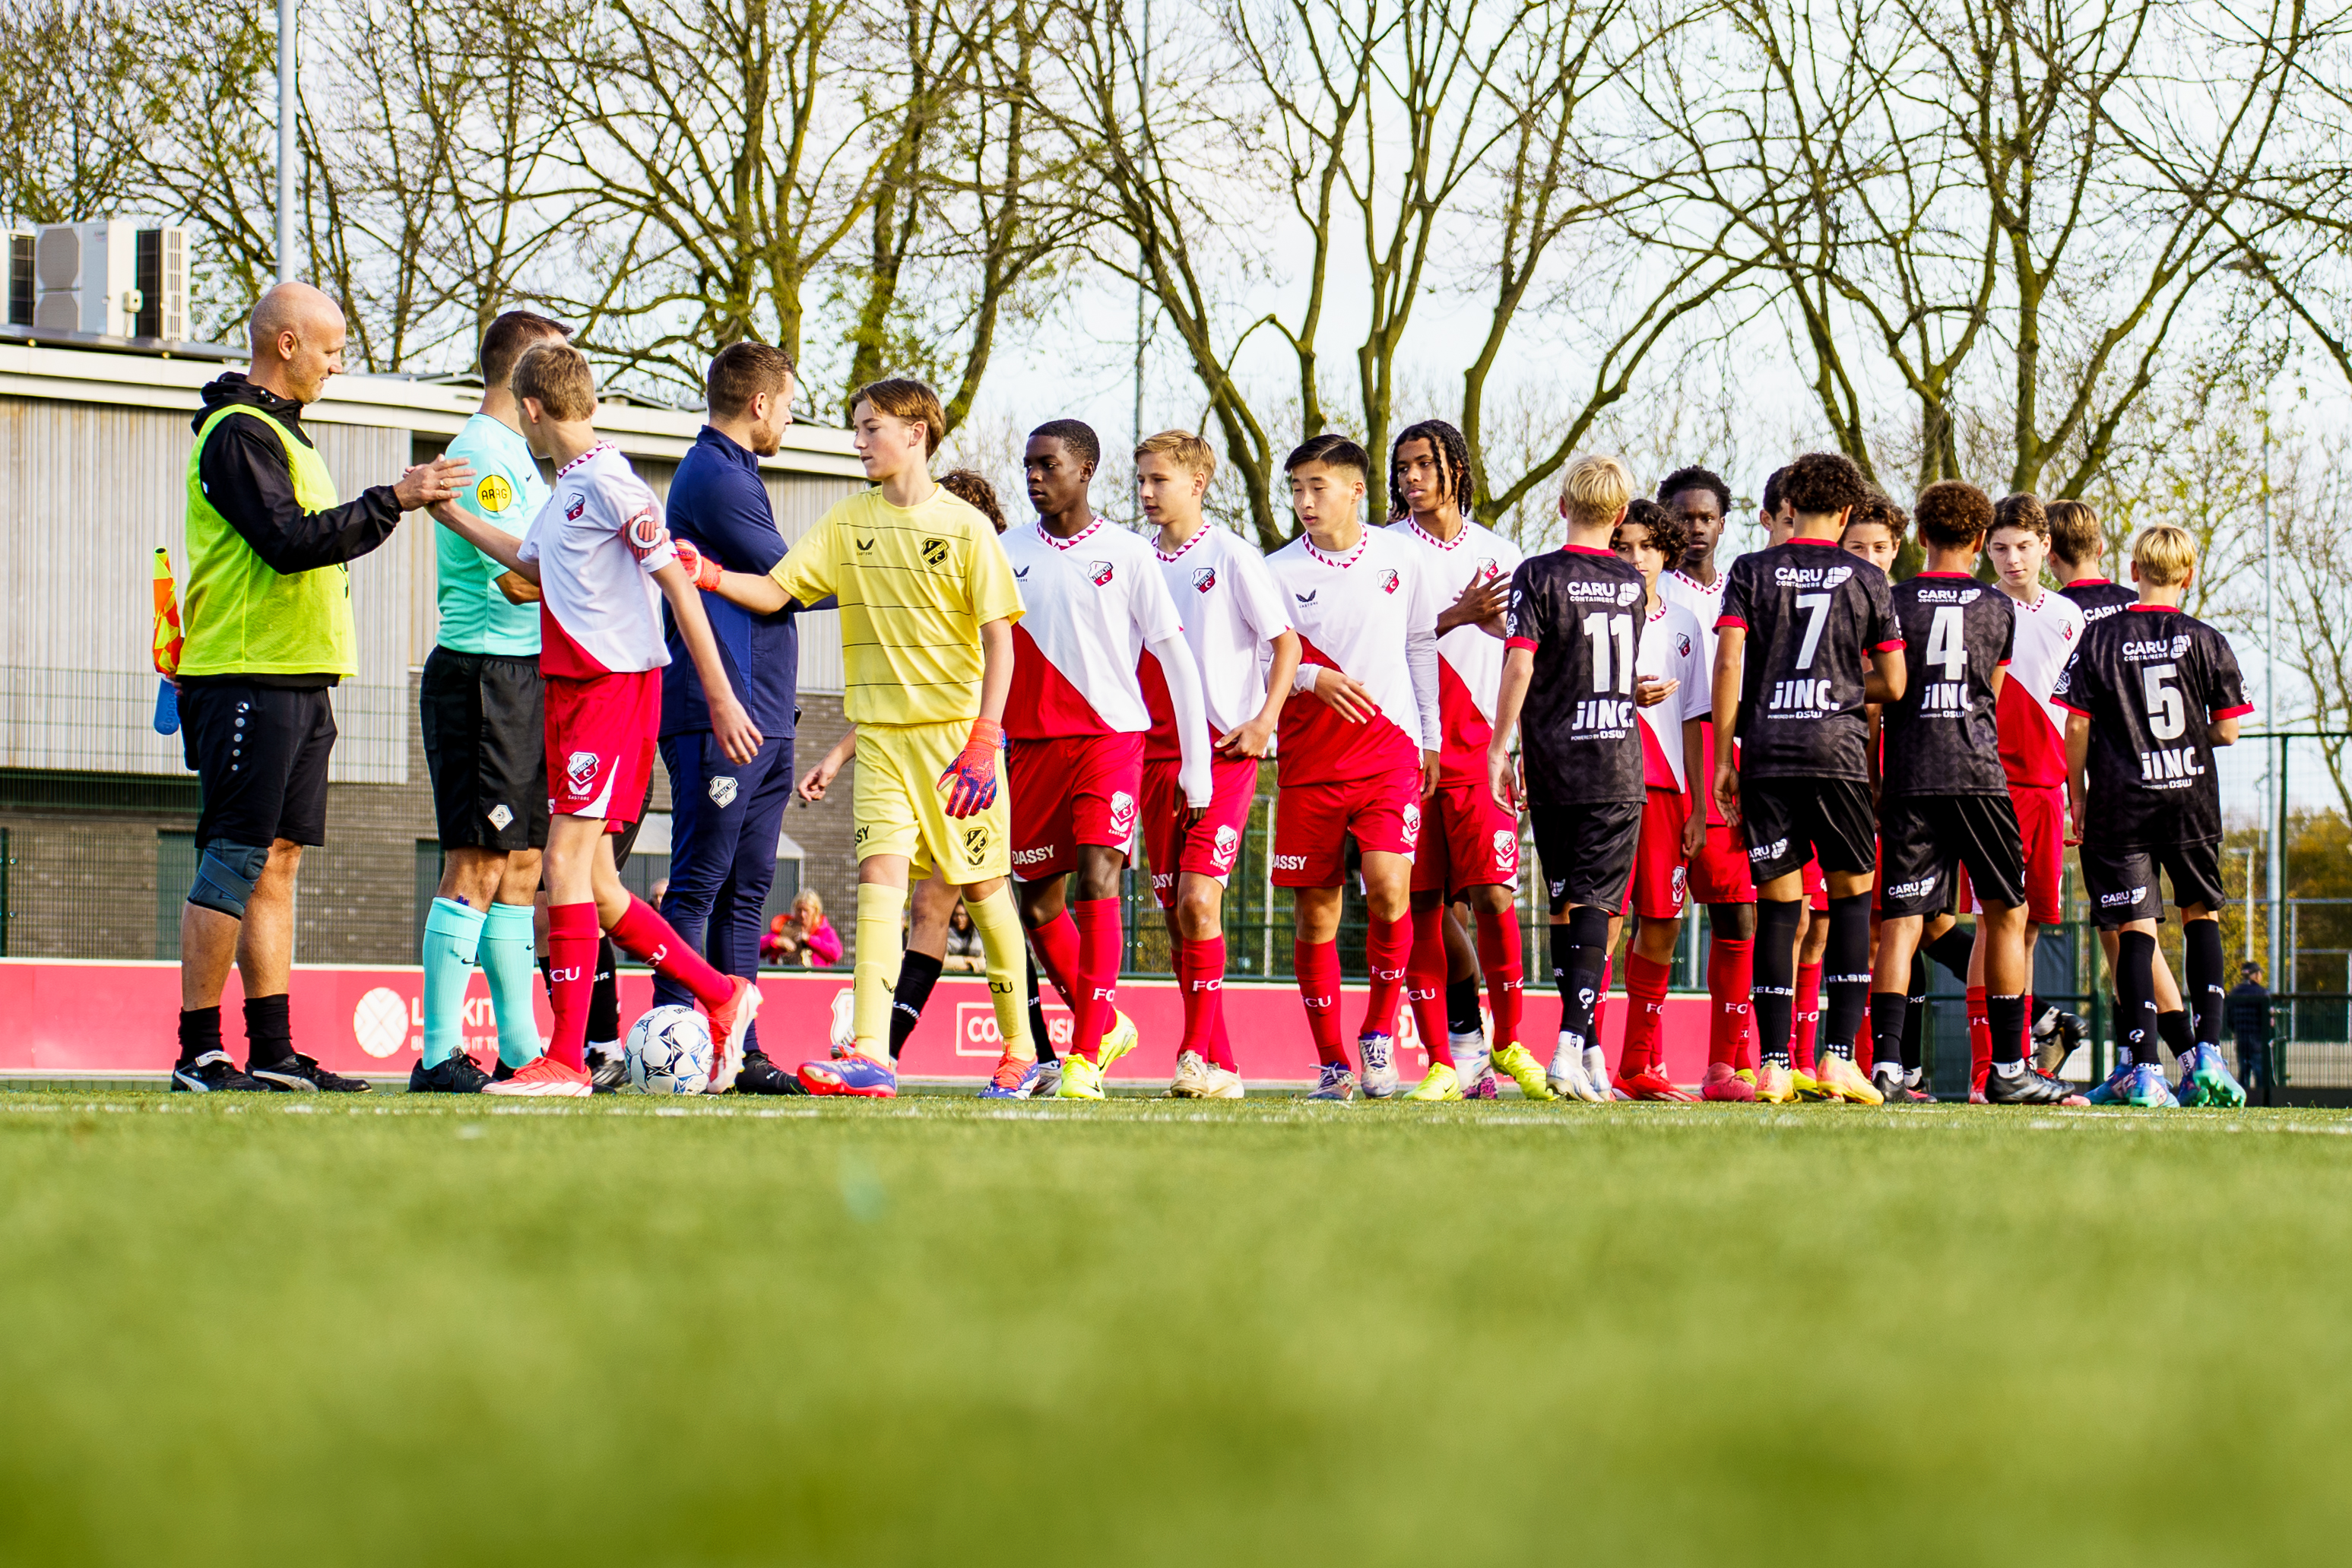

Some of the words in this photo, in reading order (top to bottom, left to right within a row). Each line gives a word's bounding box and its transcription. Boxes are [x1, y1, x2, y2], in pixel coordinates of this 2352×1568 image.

[481, 489, 508, 501] ARAG
[629, 514, 663, 549] C
[1774, 567, 1823, 583] CARU
[1205, 580, 1212, 589] C
[1390, 581, 1397, 590] C
[1567, 581, 1615, 597] CARU
[1776, 580, 1821, 589] CONTAINERS
[1570, 595, 1615, 604] CONTAINERS
[1917, 589, 1957, 600] CARU
[1796, 593, 1831, 669] 7
[1926, 607, 1968, 680] 4
[2122, 640, 2167, 656] CARU
[1583, 613, 1633, 695] 11
[2124, 653, 2168, 661] CONTAINERS
[2144, 664, 2186, 740] 5
[1795, 711, 1823, 719] DSW
[1942, 710, 1965, 718] DSW
[1599, 730, 1626, 739] DSW
[583, 768, 591, 777] C
[2168, 778, 2192, 789] DSW
[855, 825, 870, 844] SY
[969, 831, 975, 839] F
[977, 841, 984, 849] C
[1888, 882, 1919, 896] CARU
[2100, 891, 2129, 904] CARU
[550, 966, 580, 982] CU
[1503, 977, 1524, 992] FC
[1092, 987, 1115, 1003] FC
[1647, 1003, 1663, 1015] FC
[1726, 1002, 1748, 1015] FC
